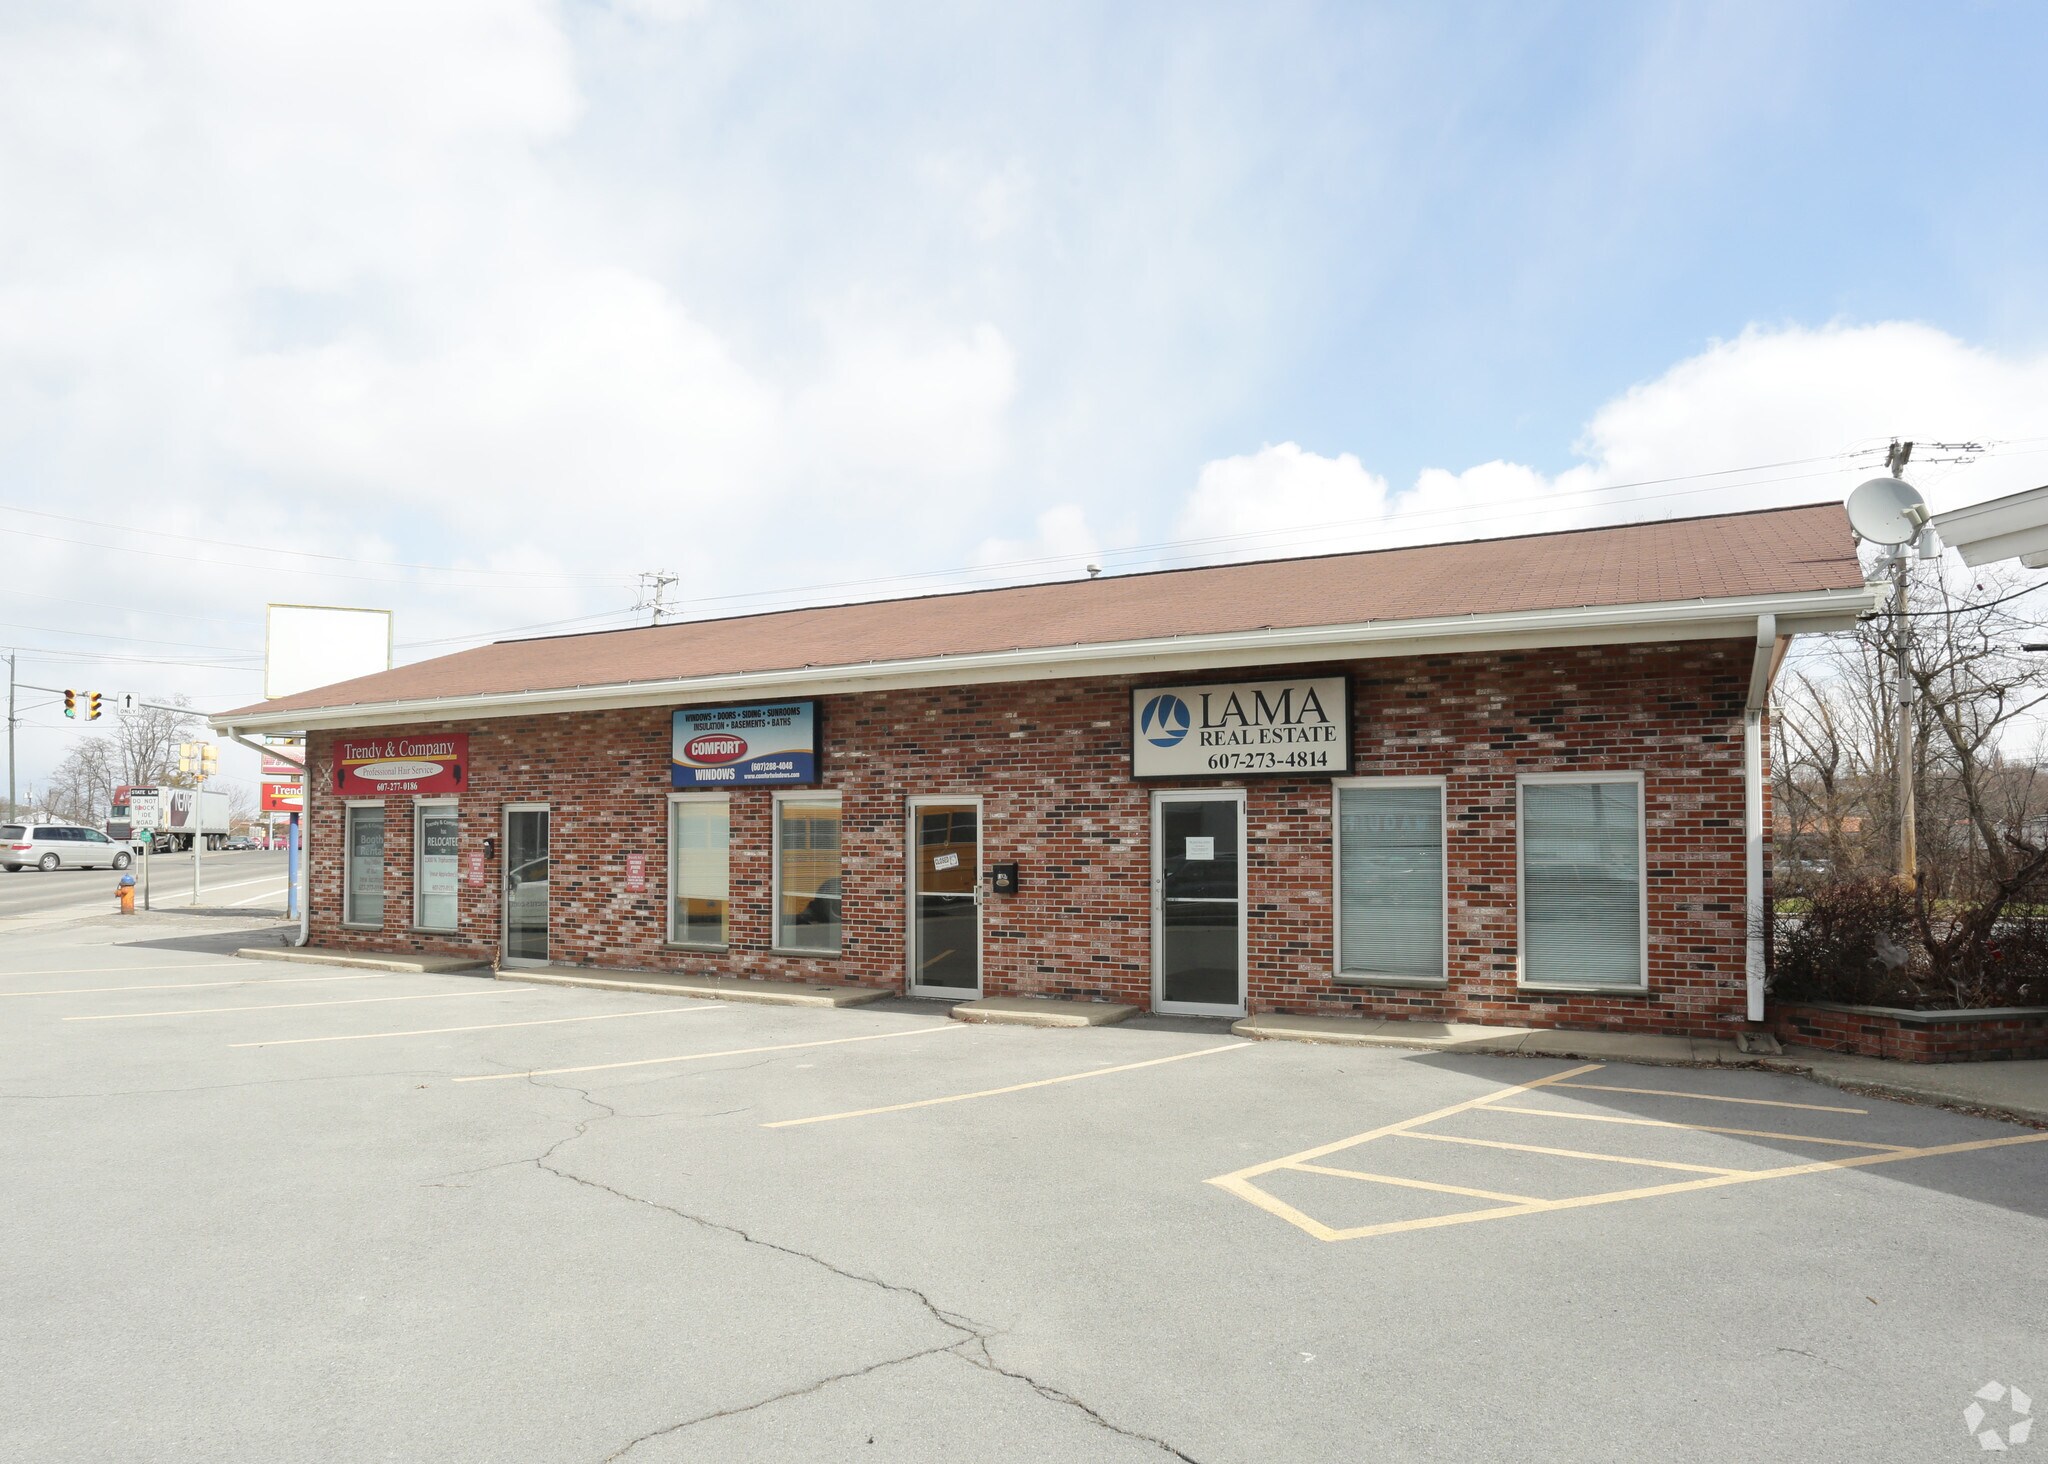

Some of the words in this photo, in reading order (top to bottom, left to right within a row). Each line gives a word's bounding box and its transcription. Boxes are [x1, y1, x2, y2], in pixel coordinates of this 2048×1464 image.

[685, 712, 712, 722] WINDOWS
[717, 711, 737, 720] DOORS
[742, 709, 761, 719] SIDING
[767, 706, 801, 717] SUNROOMS
[1199, 686, 1330, 729] LAMA
[693, 721, 725, 731] INSULATION
[730, 719, 766, 729] BASEMENTS
[771, 717, 791, 727] BATHS
[1199, 729, 1254, 746] REAL
[1258, 725, 1337, 744] ESTATE
[344, 742, 382, 762] Trendy
[384, 741, 396, 757] &
[399, 740, 455, 760] Company
[691, 740, 740, 756] COMFORT
[750, 761, 793, 772] (607)288-4048
[1208, 750, 1328, 770] 607-273-4814
[362, 767, 397, 777] Professional
[397, 766, 410, 775] Hair
[411, 765, 434, 775] Service
[695, 767, 736, 781] WINDOWS
[376, 781, 418, 791] 607-277-0186
[360, 834, 384, 844] Booth
